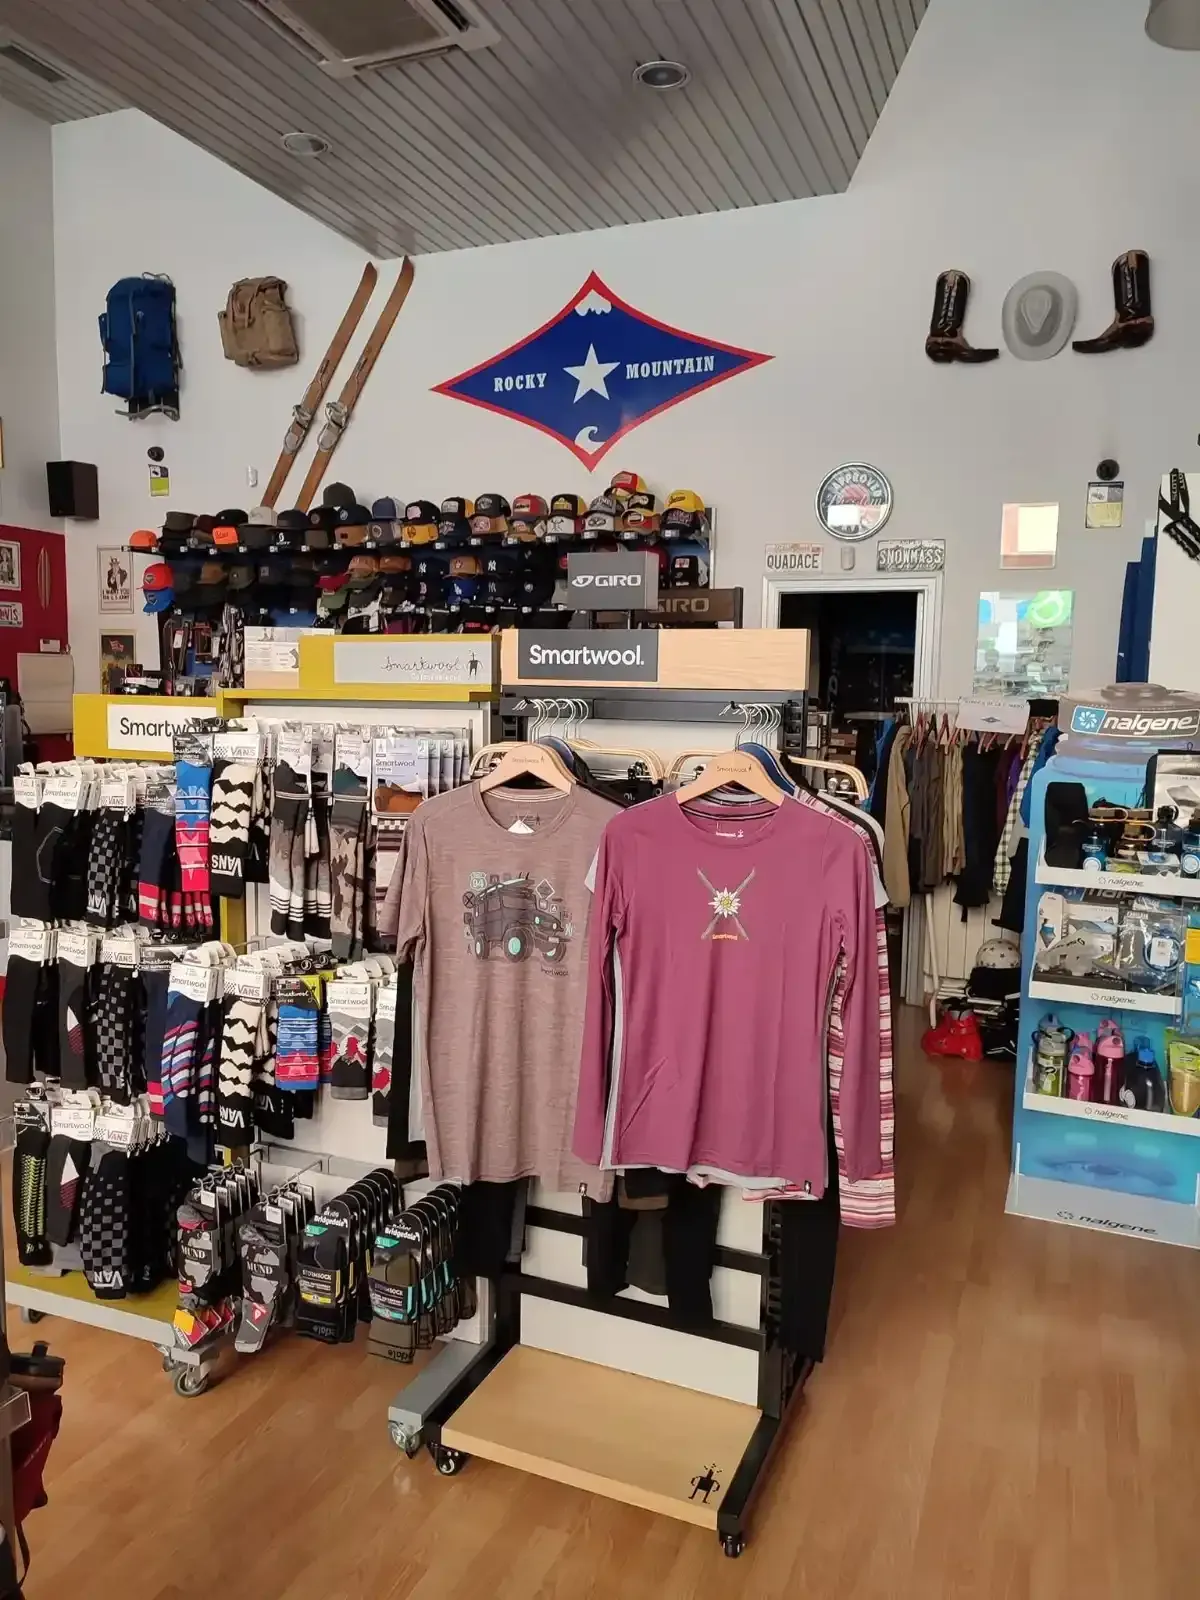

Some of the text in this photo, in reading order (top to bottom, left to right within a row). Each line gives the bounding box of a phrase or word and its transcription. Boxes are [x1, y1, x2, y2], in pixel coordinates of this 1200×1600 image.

[493, 355, 715, 392] ROCKY MOUNTAIN
[766, 553, 820, 569] QUADACE
[878, 547, 943, 566] SNOWMASS
[594, 574, 642, 587] GIRO
[381, 655, 461, 671] Smartwool
[120, 717, 212, 737] Smartwo
[1103, 714, 1195, 735] nalgene
[231, 745, 256, 756] VANS
[375, 759, 416, 767] Smartwool
[108, 795, 125, 805] VANS
[211, 854, 243, 877] VANS
[114, 951, 133, 963] VANS
[171, 975, 207, 989] Smartwool
[237, 983, 261, 997] VANS
[329, 996, 369, 1006] Smartwool
[53, 1120, 92, 1130] Smartwool
[107, 1129, 130, 1142] VANS
[313, 1214, 345, 1227] Bridgedale
[384, 1226, 417, 1241] Bridgedale
[180, 1244, 206, 1260] MUND
[246, 1260, 273, 1275] MUND
